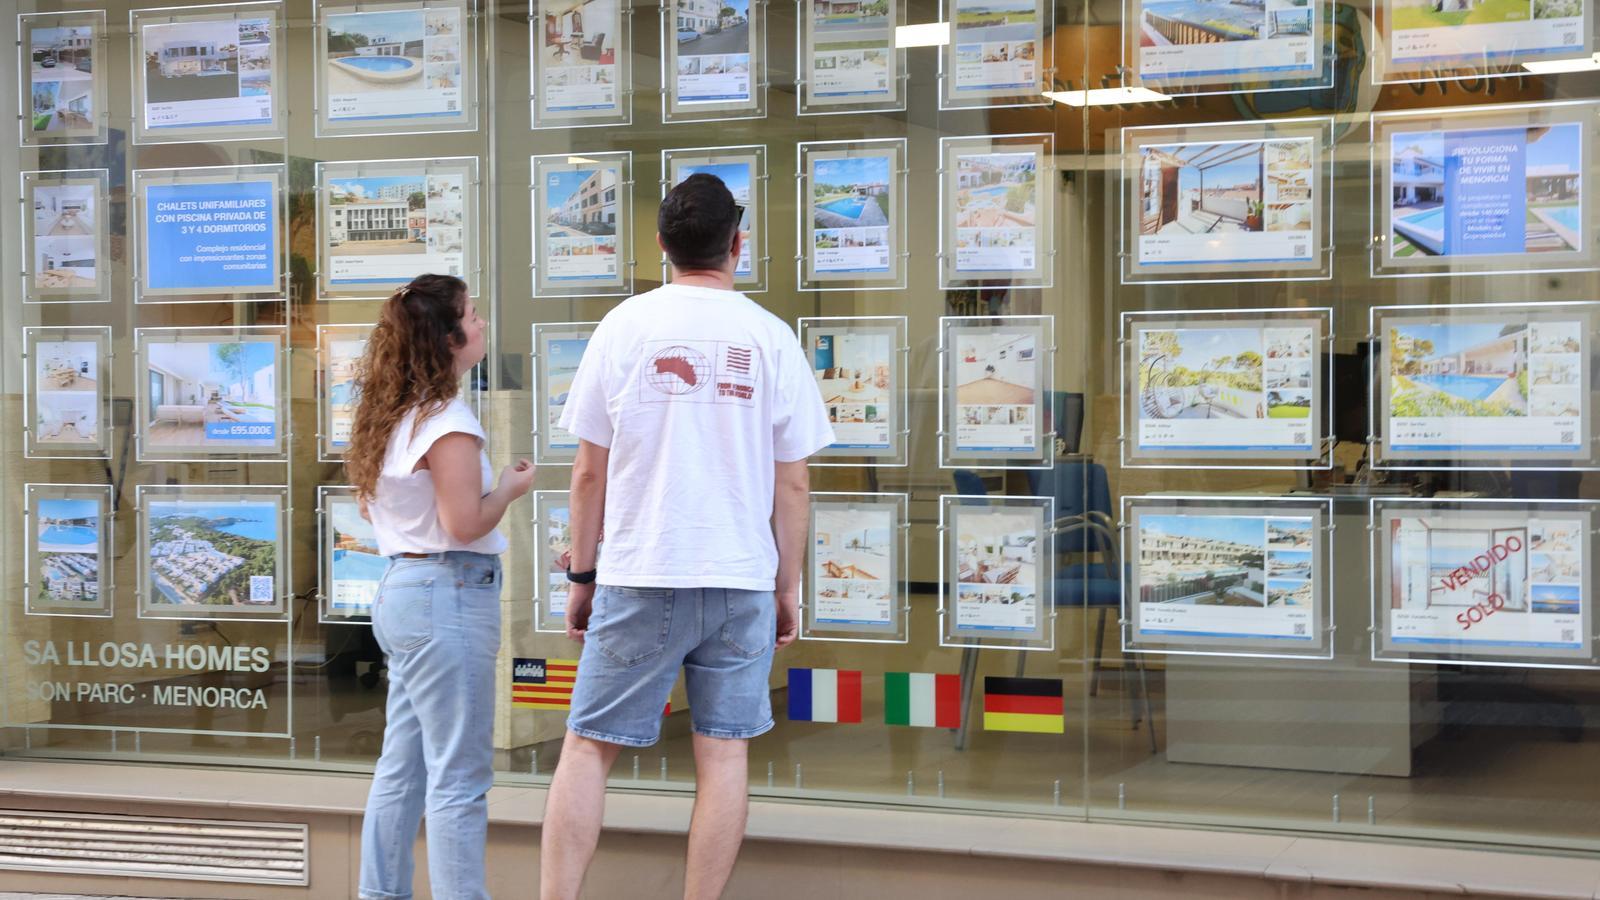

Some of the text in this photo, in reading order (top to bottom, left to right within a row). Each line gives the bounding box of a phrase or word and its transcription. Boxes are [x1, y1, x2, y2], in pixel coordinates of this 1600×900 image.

[1462, 154, 1508, 165] TU FORMA
[1459, 164, 1511, 175] DE VIVIR EN
[157, 199, 266, 212] CHALETS UNIFAMILIARES
[155, 211, 266, 223] CON PISCINA PRIVADA DE
[182, 226, 188, 234] 3
[188, 225, 195, 234] Y
[203, 223, 267, 233] DORMITORIOS
[196, 244, 229, 253] Complejo
[193, 254, 245, 263] impresionantes
[230, 425, 273, 435] 695.000€
[1440, 535, 1522, 591] VENDIDO
[1456, 592, 1504, 631] SOLD
[24, 639, 271, 673] SA LLOSA HOMES
[25, 680, 268, 710] SON PARC MENORCA
